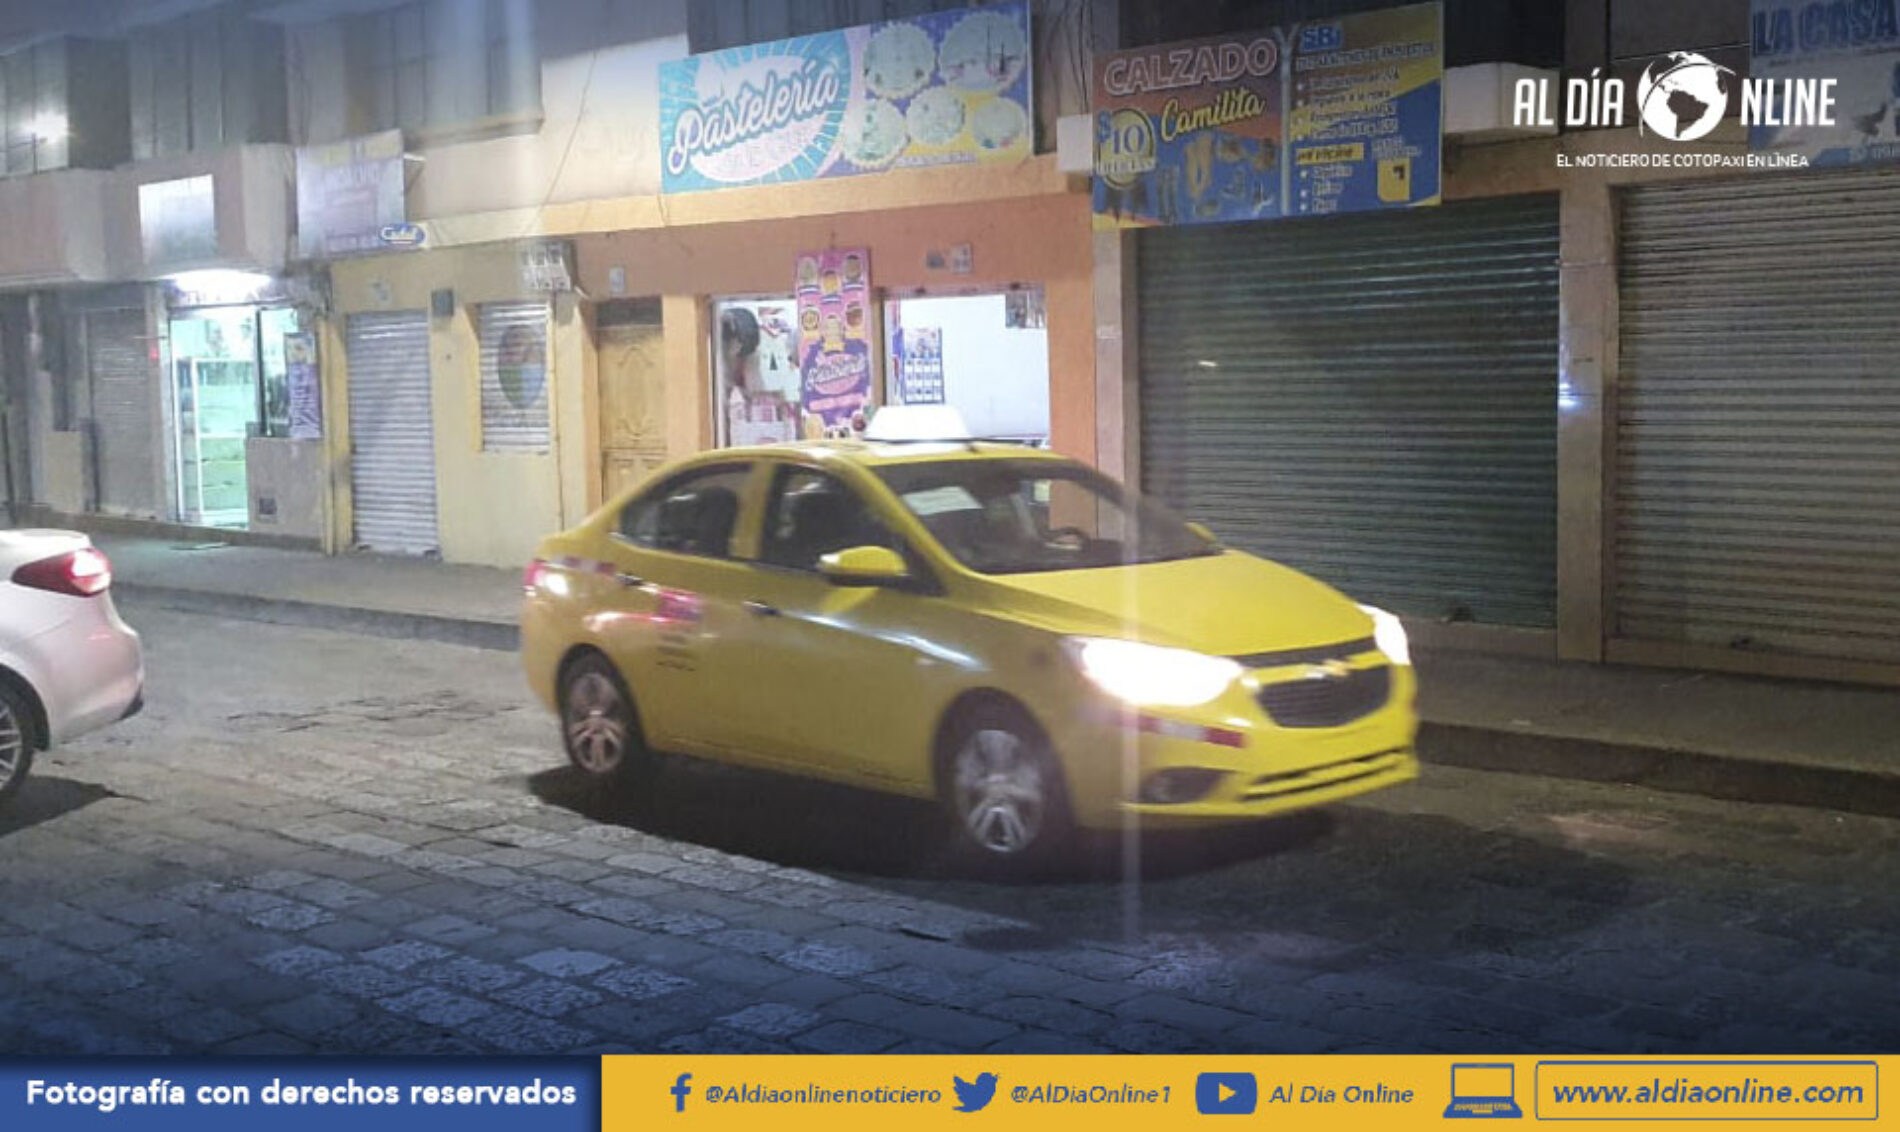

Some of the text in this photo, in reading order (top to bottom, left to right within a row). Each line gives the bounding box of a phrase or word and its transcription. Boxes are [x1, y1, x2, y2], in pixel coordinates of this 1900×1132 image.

[1104, 38, 1278, 96] CALZADO
[668, 58, 839, 175] Pastelería
[1161, 86, 1266, 142] Camilita
